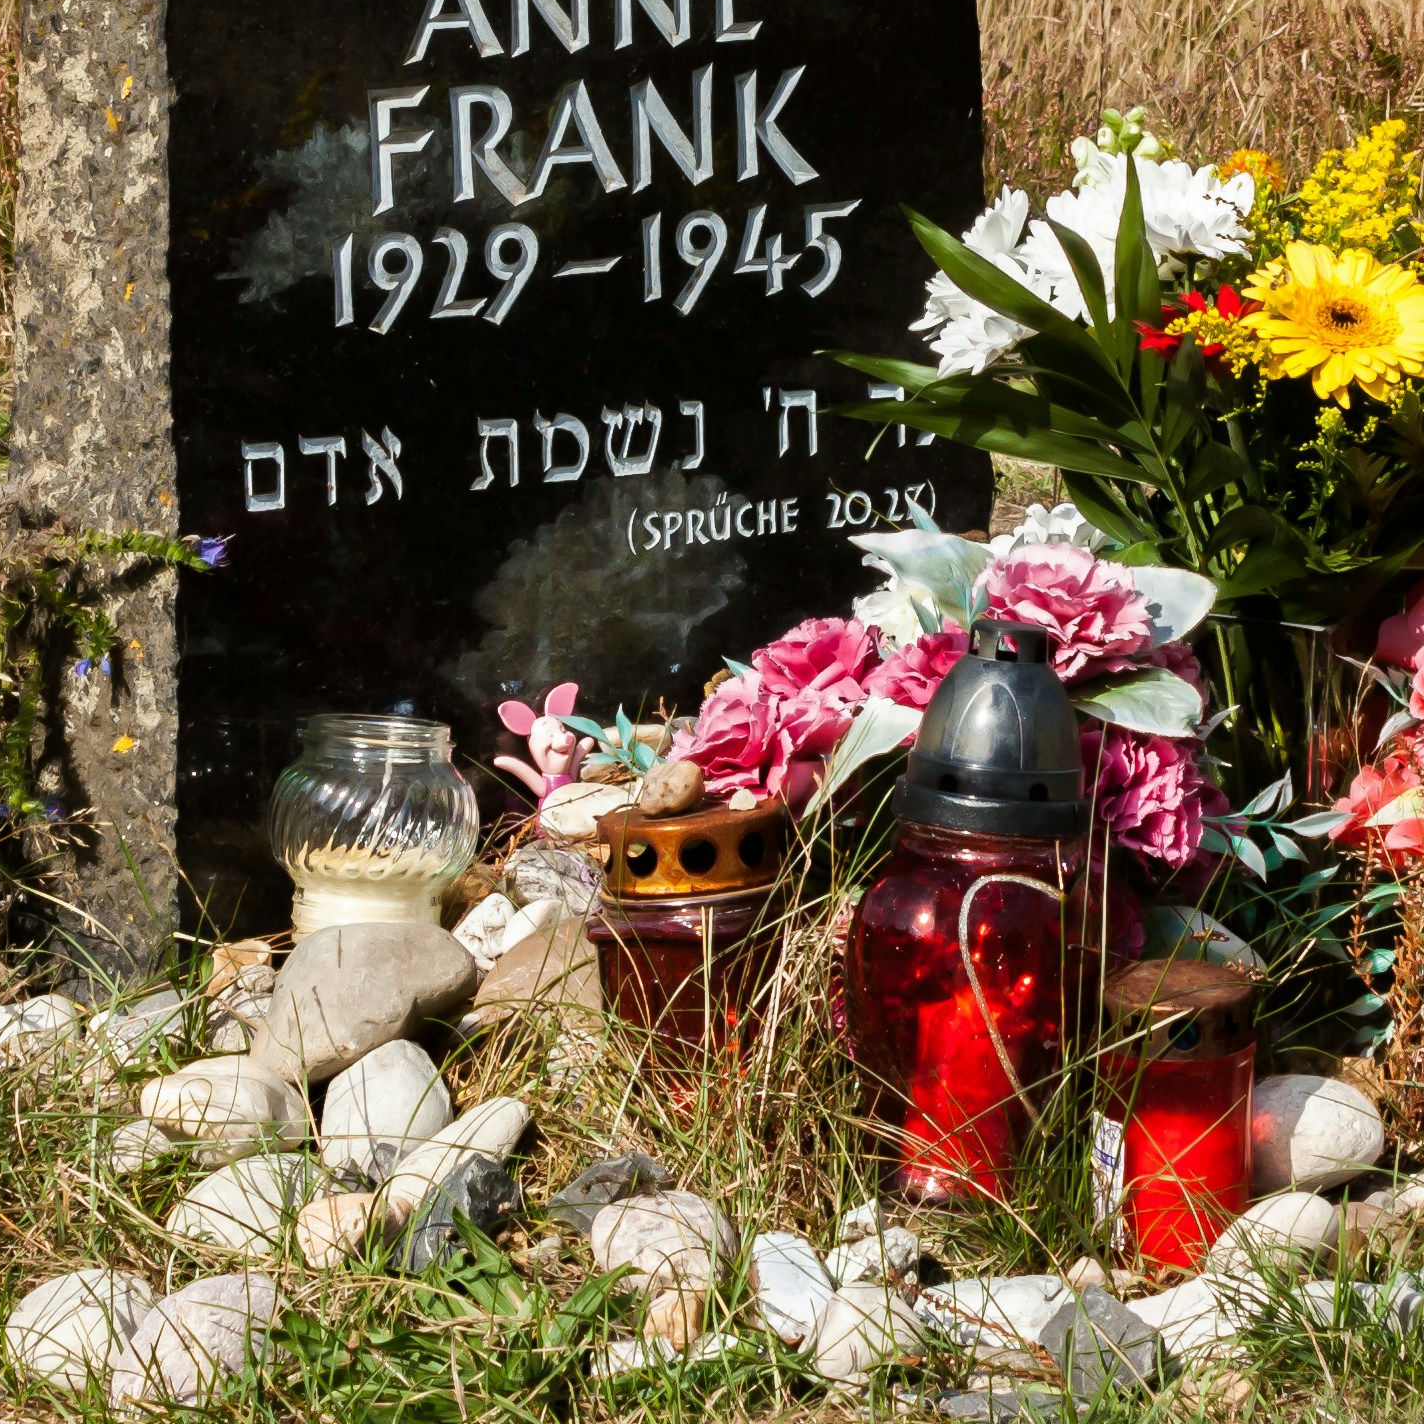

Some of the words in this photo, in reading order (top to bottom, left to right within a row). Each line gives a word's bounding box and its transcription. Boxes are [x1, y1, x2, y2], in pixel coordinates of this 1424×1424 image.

[367, 62, 820, 217] FRANK
[241, 424, 404, 513] אדם
[469, 399, 706, 491] נשמת
[627, 491, 800, 556] (SPRÜCHE
